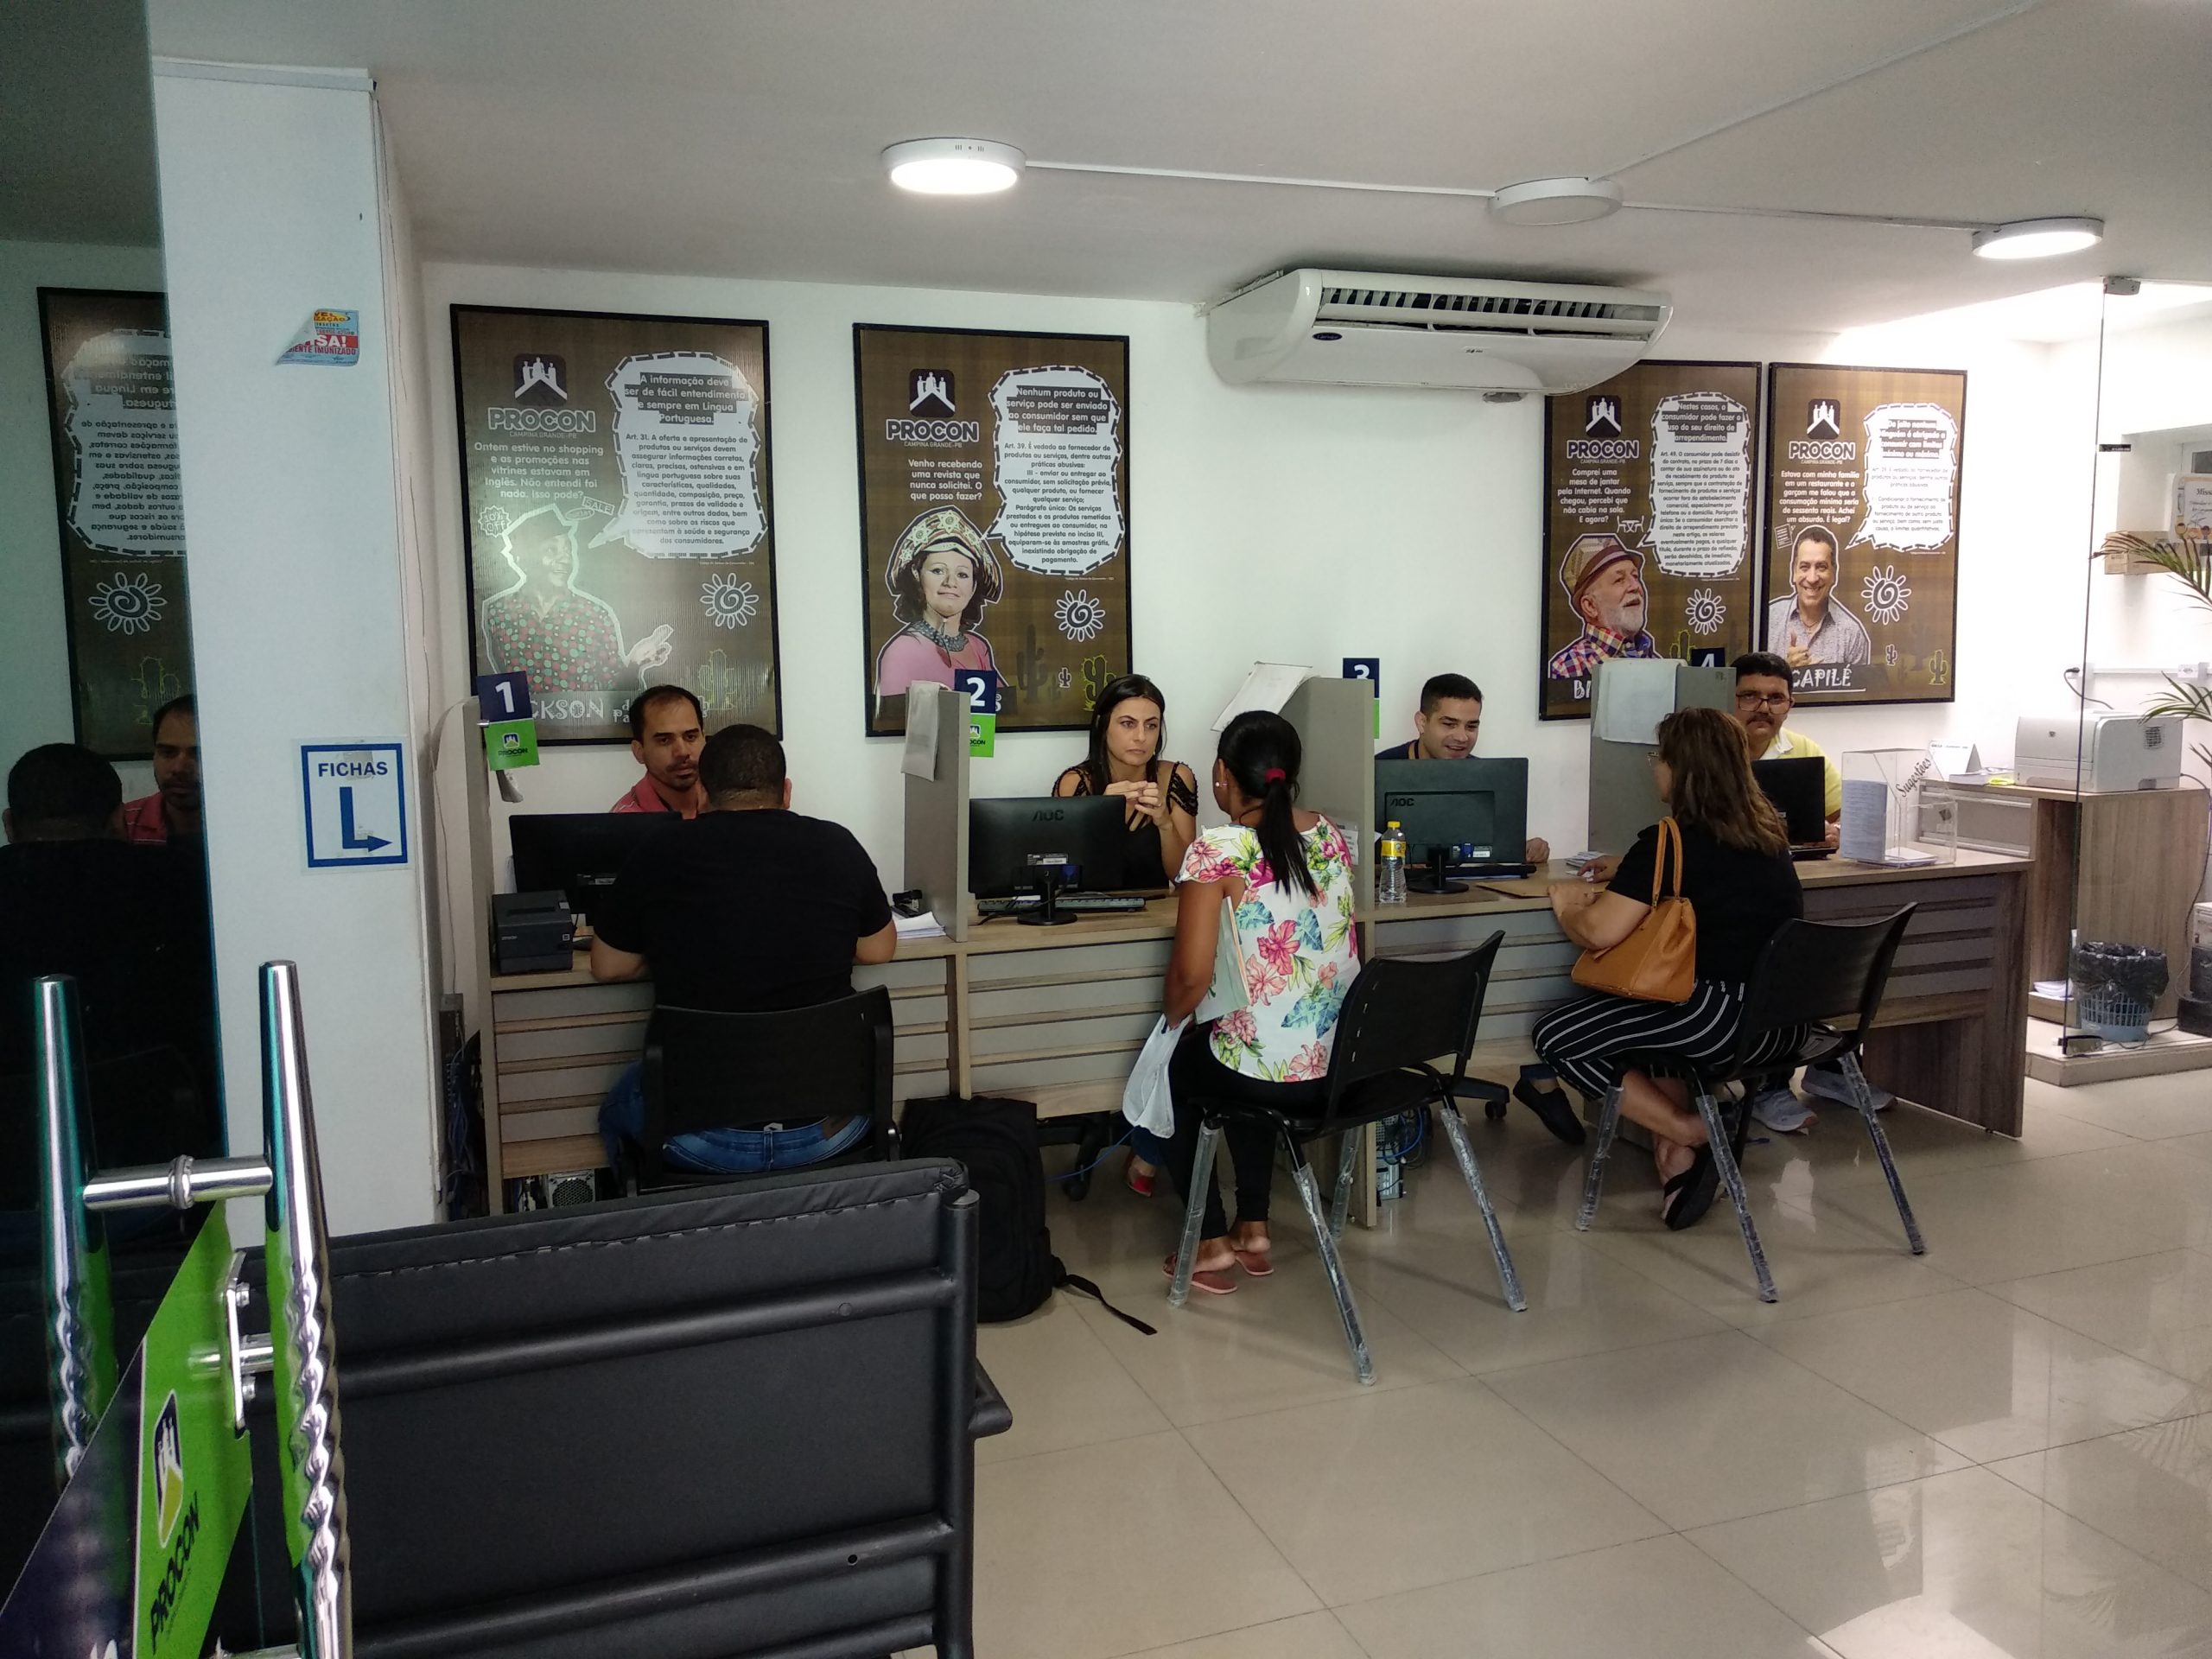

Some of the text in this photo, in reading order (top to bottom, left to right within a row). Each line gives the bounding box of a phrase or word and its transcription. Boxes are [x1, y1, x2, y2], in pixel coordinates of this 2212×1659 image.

[315, 346, 356, 355] IMUNIZADO
[640, 375, 646, 384] A
[650, 375, 703, 387] informação
[641, 387, 653, 397] de
[657, 387, 677, 397] fácil
[680, 388, 745, 399] entendimento
[1017, 388, 1051, 397] Nenhum
[1053, 389, 1085, 399] produto
[646, 403, 681, 411] sempre
[1007, 399, 1034, 410] serviço
[1037, 400, 1058, 410] pode
[1075, 401, 1108, 410] enviado
[488, 407, 596, 433] PROCON
[659, 413, 714, 425] Portuguesa.
[1021, 411, 1069, 421] consumidor
[1090, 415, 1106, 423] que
[886, 419, 980, 442] PROCON
[1033, 423, 1051, 434] faça
[1053, 423, 1064, 432] tal
[1066, 423, 1096, 435] pedido.
[1675, 434, 1727, 442] arrependimento.
[474, 442, 508, 452] Ontem
[511, 443, 539, 453] estive
[558, 444, 604, 455] shopping
[639, 443, 670, 453] produtos
[683, 444, 710, 453] serviços
[1567, 440, 1640, 459] PROCON
[1789, 441, 1856, 460] PROCON
[515, 454, 569, 467] promoções
[669, 453, 712, 462] informações
[714, 454, 744, 463] corretas,
[908, 459, 982, 468] Venho recebendo
[491, 466, 526, 475] vitrines
[531, 466, 571, 475] estavam
[933, 470, 961, 479] revista
[1572, 467, 1600, 477] Comprei
[520, 478, 541, 487] Não
[544, 478, 581, 487] entendi
[584, 479, 598, 487] foi
[938, 481, 972, 490] solicitei.
[975, 481, 982, 490] O
[1599, 477, 1620, 486] jantar
[499, 488, 584, 500] nada. Isso pode?
[929, 493, 953, 502] posso
[956, 492, 982, 500] fazer?
[1557, 487, 1572, 496] pela
[1560, 496, 1586, 505] chegou,
[1588, 496, 1613, 505] percebi
[1585, 515, 1609, 524] agora?
[1791, 663, 1852, 689] CAPILÉ
[495, 681, 515, 713] 1
[966, 677, 986, 707] 2
[530, 698, 604, 720] CKSON
[498, 747, 528, 756] PROCON
[317, 760, 389, 778] FICHAS
[1389, 798, 1414, 806] AOC
[1032, 810, 1064, 822] AOC
[150, 1490, 200, 1656] PROCON
